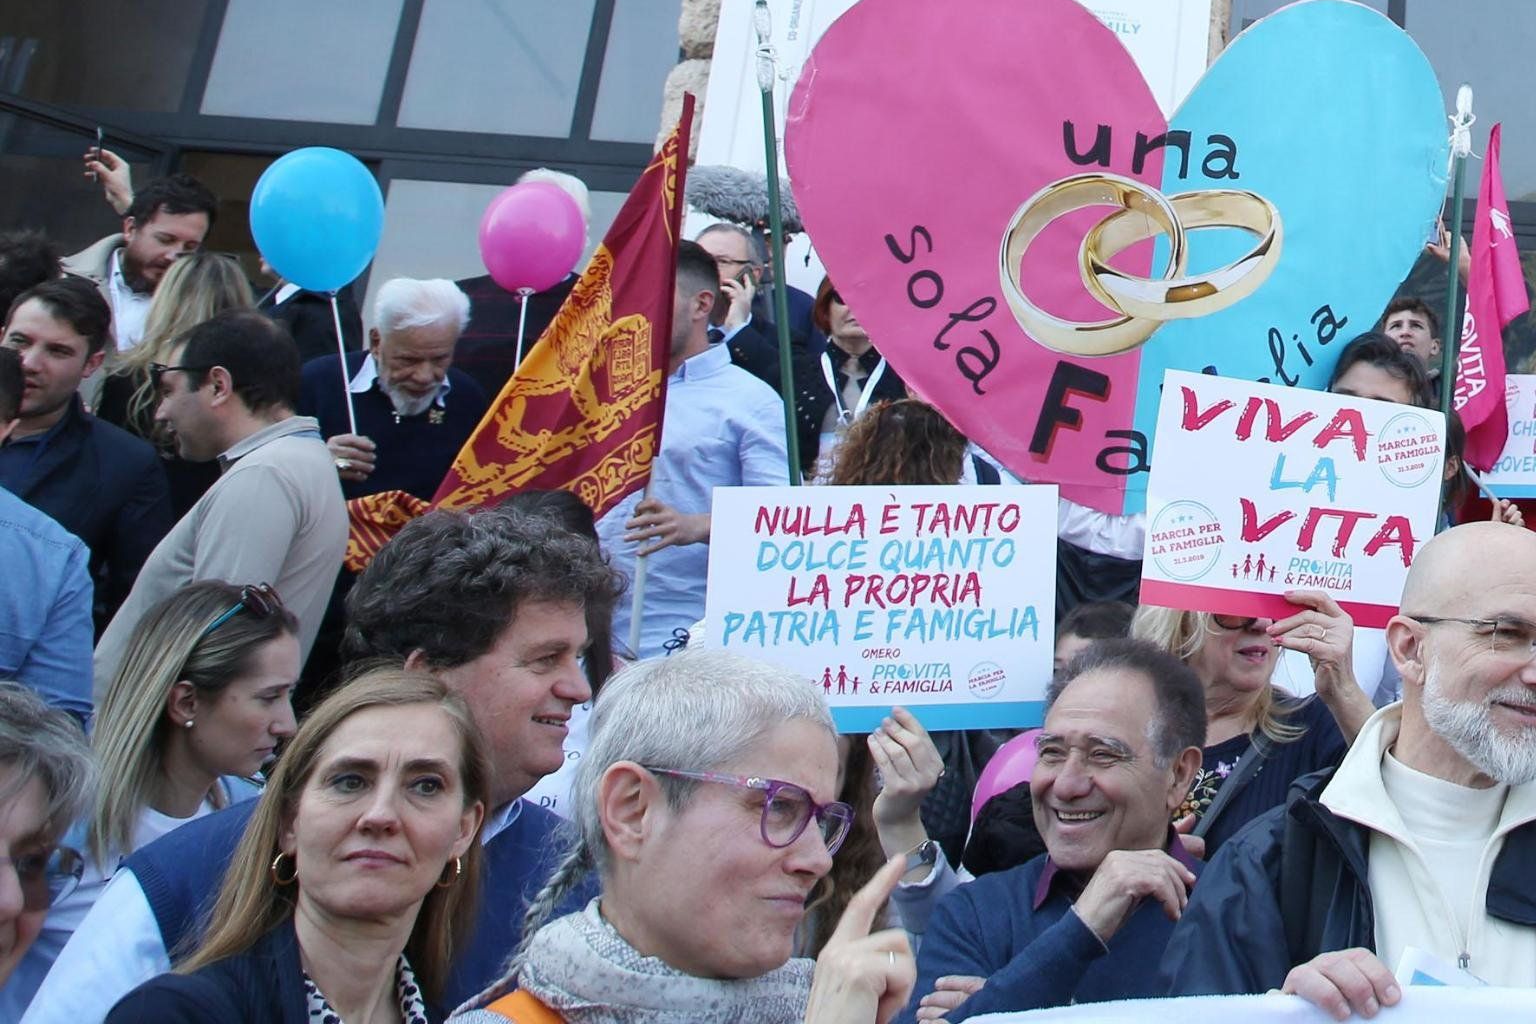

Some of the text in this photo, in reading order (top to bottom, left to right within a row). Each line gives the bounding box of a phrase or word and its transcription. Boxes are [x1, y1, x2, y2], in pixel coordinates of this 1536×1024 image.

[1062, 119, 1240, 180] una
[884, 224, 1000, 396] sola
[1180, 385, 1374, 462] VIVA
[1378, 434, 1437, 452] MARCIA PER
[1378, 445, 1440, 463] LA FAMIGLIA
[1270, 452, 1342, 502] LA
[754, 493, 1021, 538] NULLA È TANTO
[1152, 523, 1222, 542] MARCIA PER
[1240, 497, 1421, 568] VITA
[756, 537, 1016, 573] DOLCE QUANTO
[1152, 535, 1225, 555] LA FAMIGLIA
[787, 571, 982, 609] LA PROPRIA
[1285, 575, 1352, 591] & FAMIGLIA
[723, 605, 1039, 648] PATRIA E FAMIGLIA
[861, 648, 901, 659] OMERO
[869, 680, 953, 694] & FAMIGLIA
